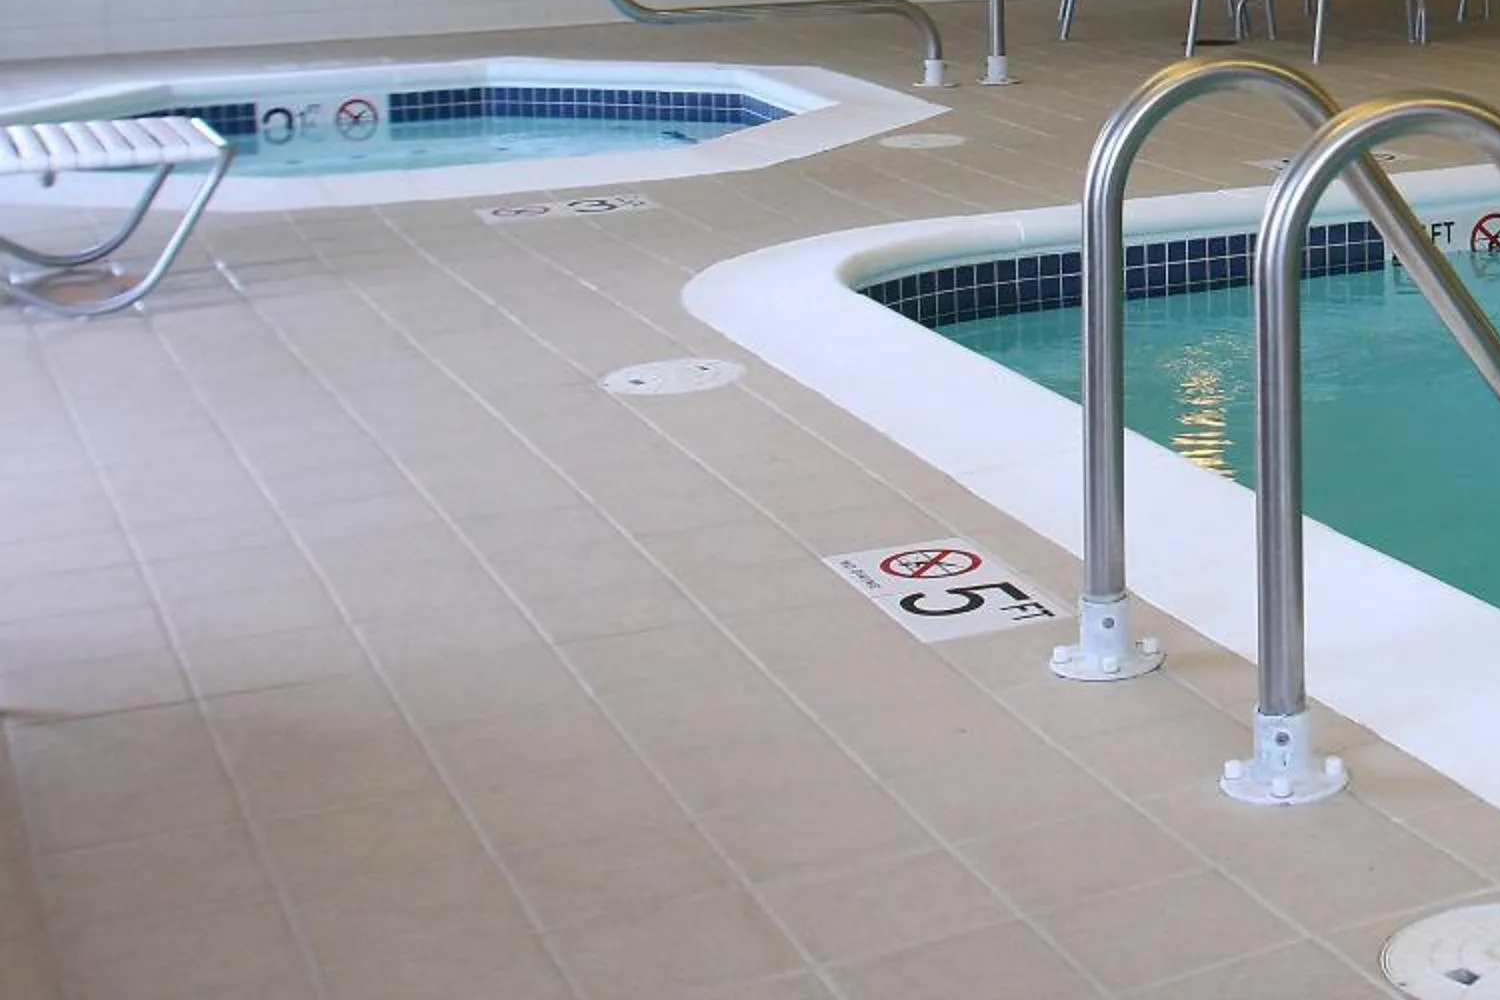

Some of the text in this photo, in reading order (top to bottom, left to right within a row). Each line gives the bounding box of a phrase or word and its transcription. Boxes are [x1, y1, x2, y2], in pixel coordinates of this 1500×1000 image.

[1431, 221, 1456, 244] FT
[900, 581, 1055, 621] 5 FT
